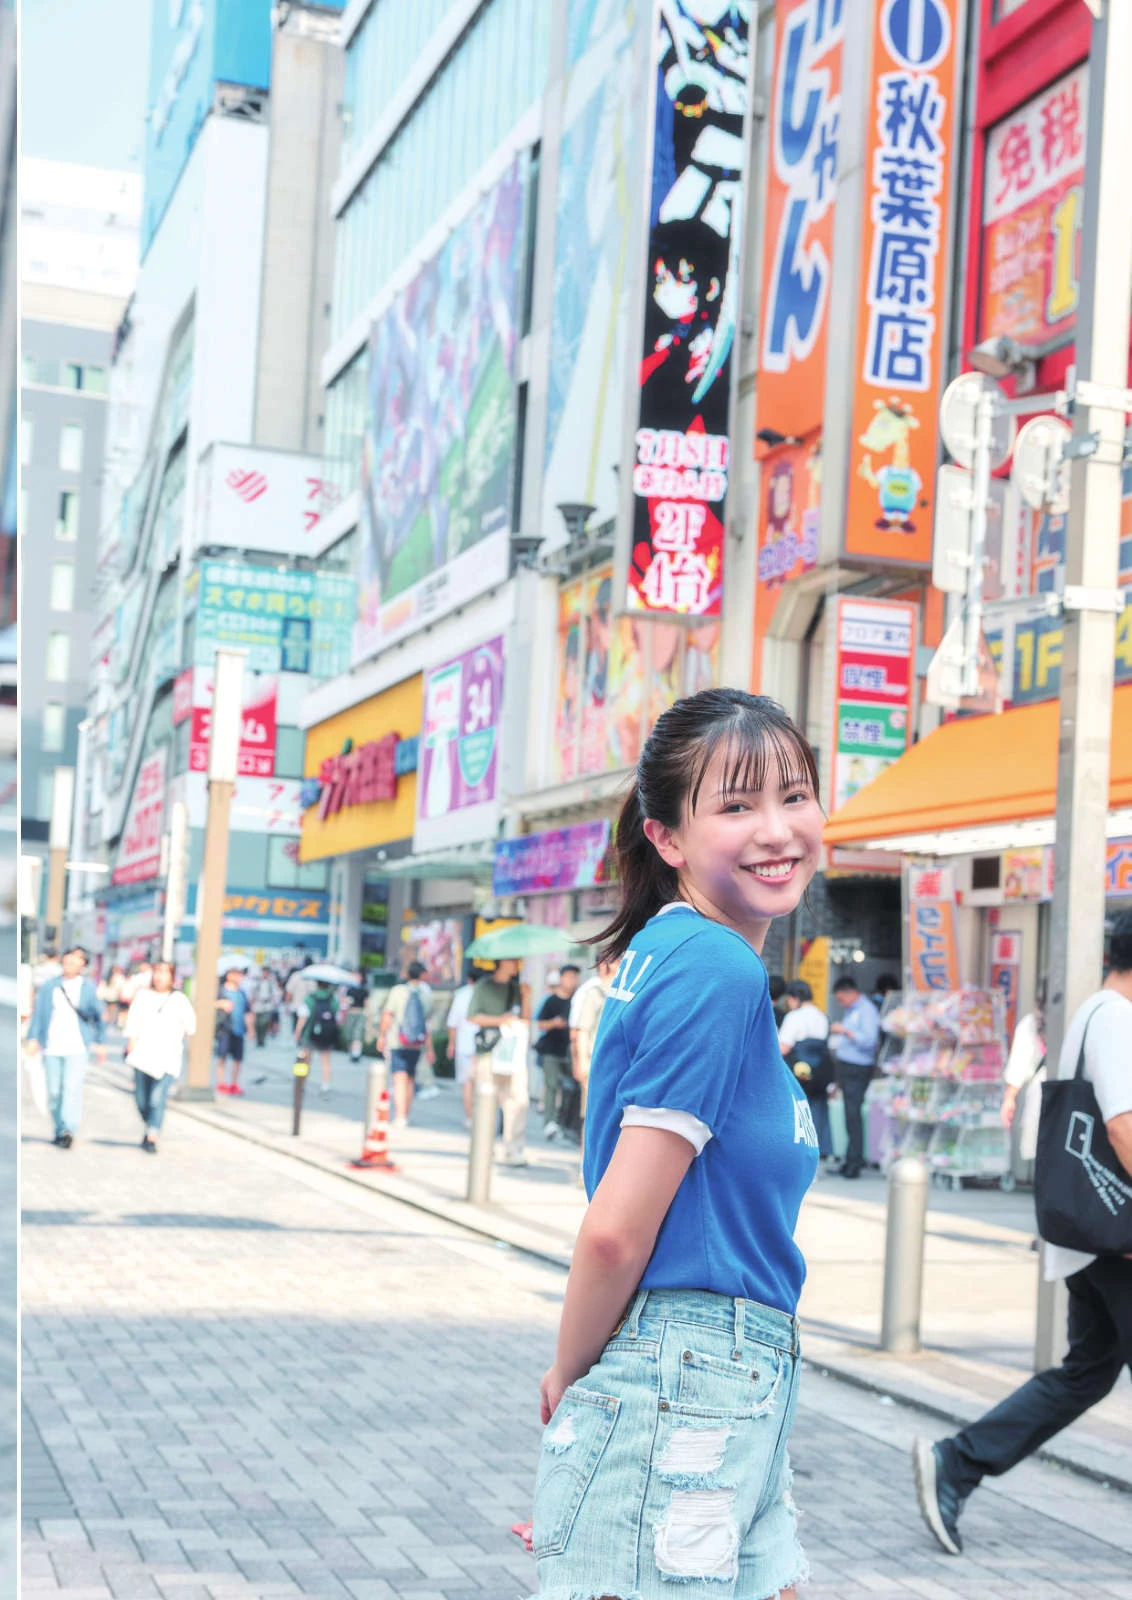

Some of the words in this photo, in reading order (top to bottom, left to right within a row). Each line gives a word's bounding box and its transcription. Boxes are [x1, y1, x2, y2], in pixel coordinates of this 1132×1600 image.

[994, 80, 1083, 205] 免税
[872, 78, 938, 384] 秋葉原店
[843, 720, 881, 744] 禁煙
